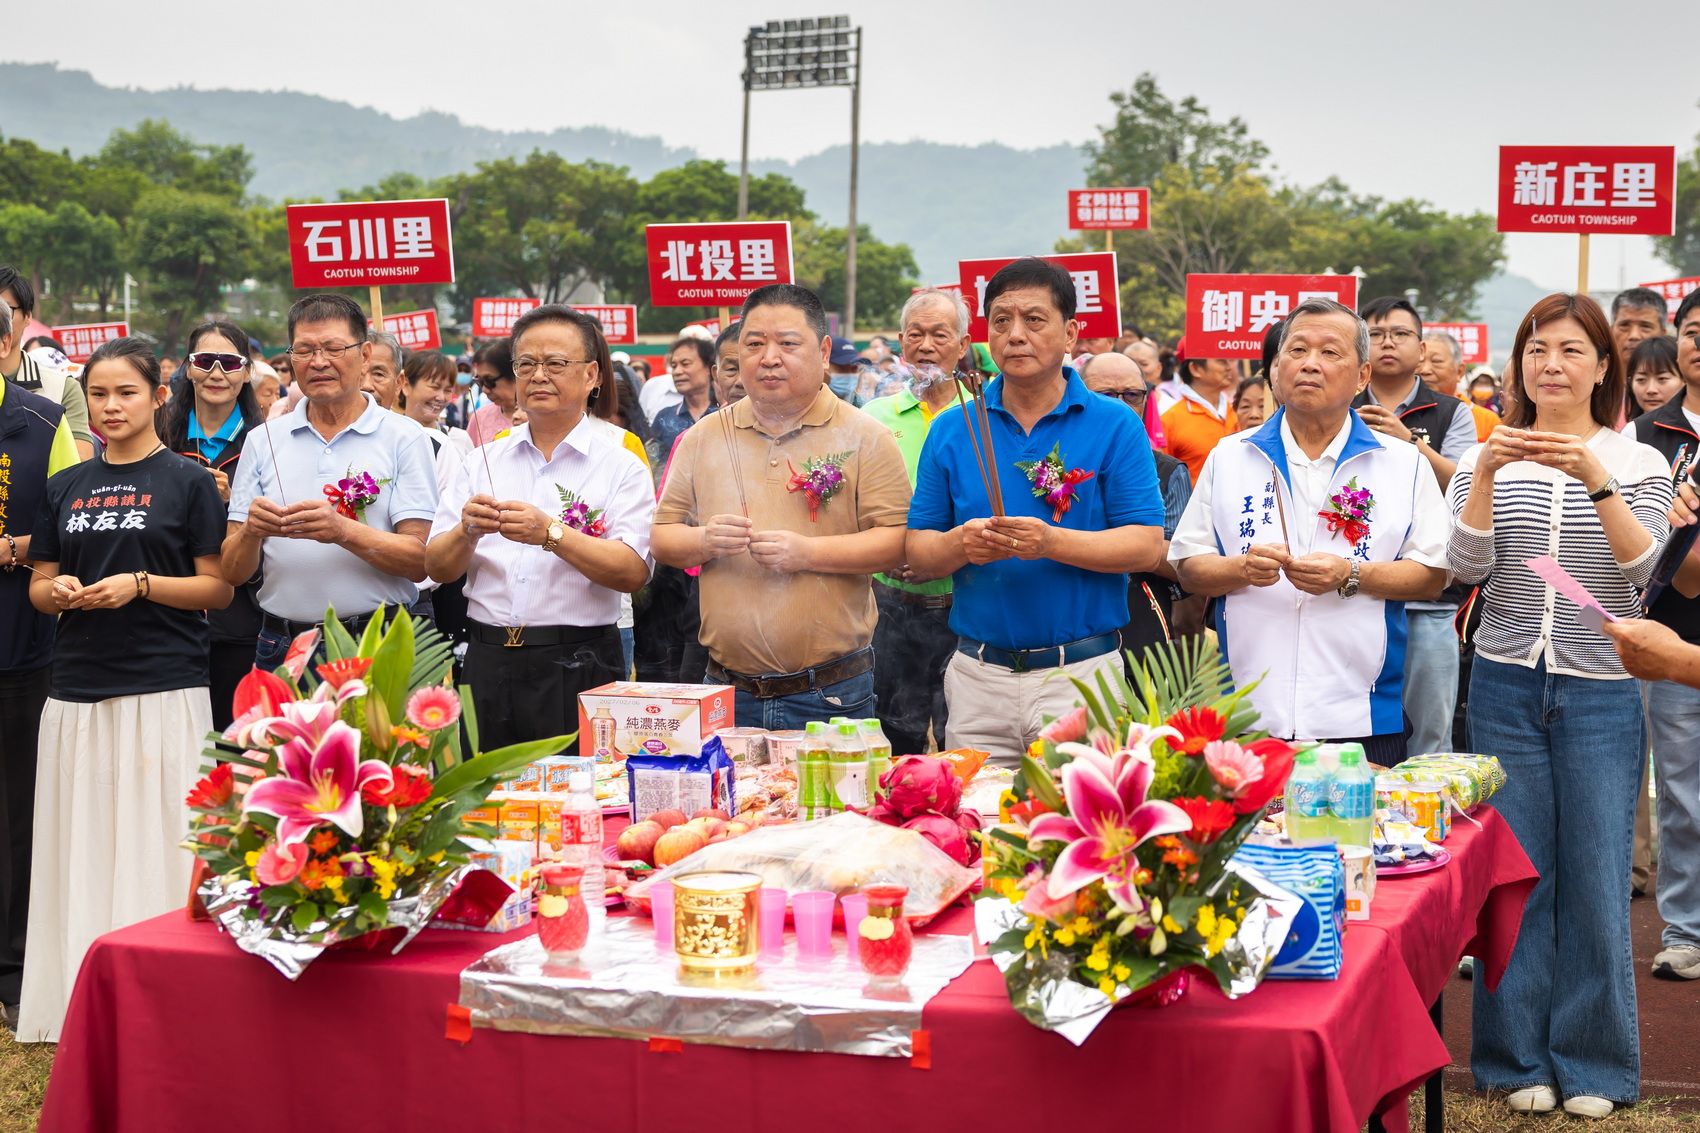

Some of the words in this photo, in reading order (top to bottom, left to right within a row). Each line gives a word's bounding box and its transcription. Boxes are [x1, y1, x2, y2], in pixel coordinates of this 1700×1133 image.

[1513, 162, 1657, 208] 新庄里
[1531, 214, 1575, 225] CAOTUN
[1578, 215, 1637, 225] TOWNSHIP
[302, 216, 435, 262] 石川里
[660, 239, 777, 281] 北投里
[324, 268, 364, 279] CAOTUN
[367, 266, 420, 277] TOWNSHIP
[678, 289, 714, 298] CAOTUN
[716, 288, 756, 298] TOWNSH
[1201, 290, 1339, 333] 御史
[1218, 340, 1261, 350] CAOTUN
[70, 494, 153, 511] 南投縣議員
[1261, 482, 1275, 525] 副縣長
[65, 509, 148, 533] 林友友
[626, 716, 681, 732] 純濃燕麥
